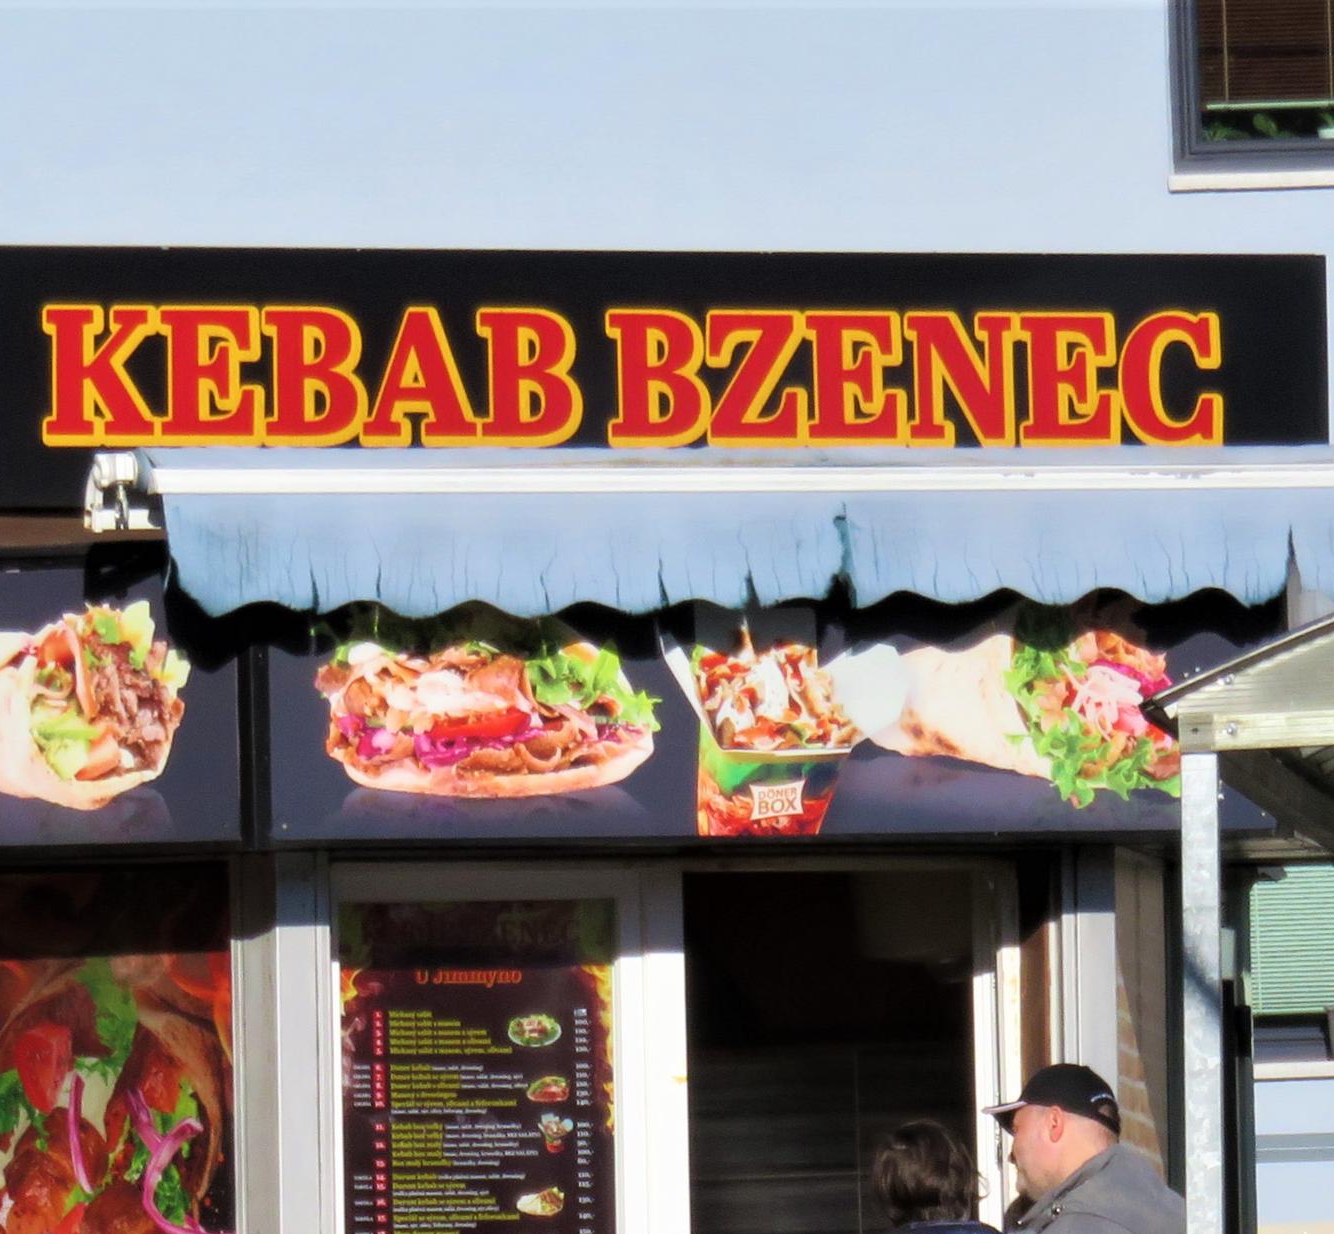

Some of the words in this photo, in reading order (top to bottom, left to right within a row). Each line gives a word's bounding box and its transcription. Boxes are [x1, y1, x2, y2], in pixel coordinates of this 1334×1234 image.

[42, 304, 584, 447] KEBAB
[605, 308, 1224, 447] BZENEC
[758, 798, 797, 815] BOX
